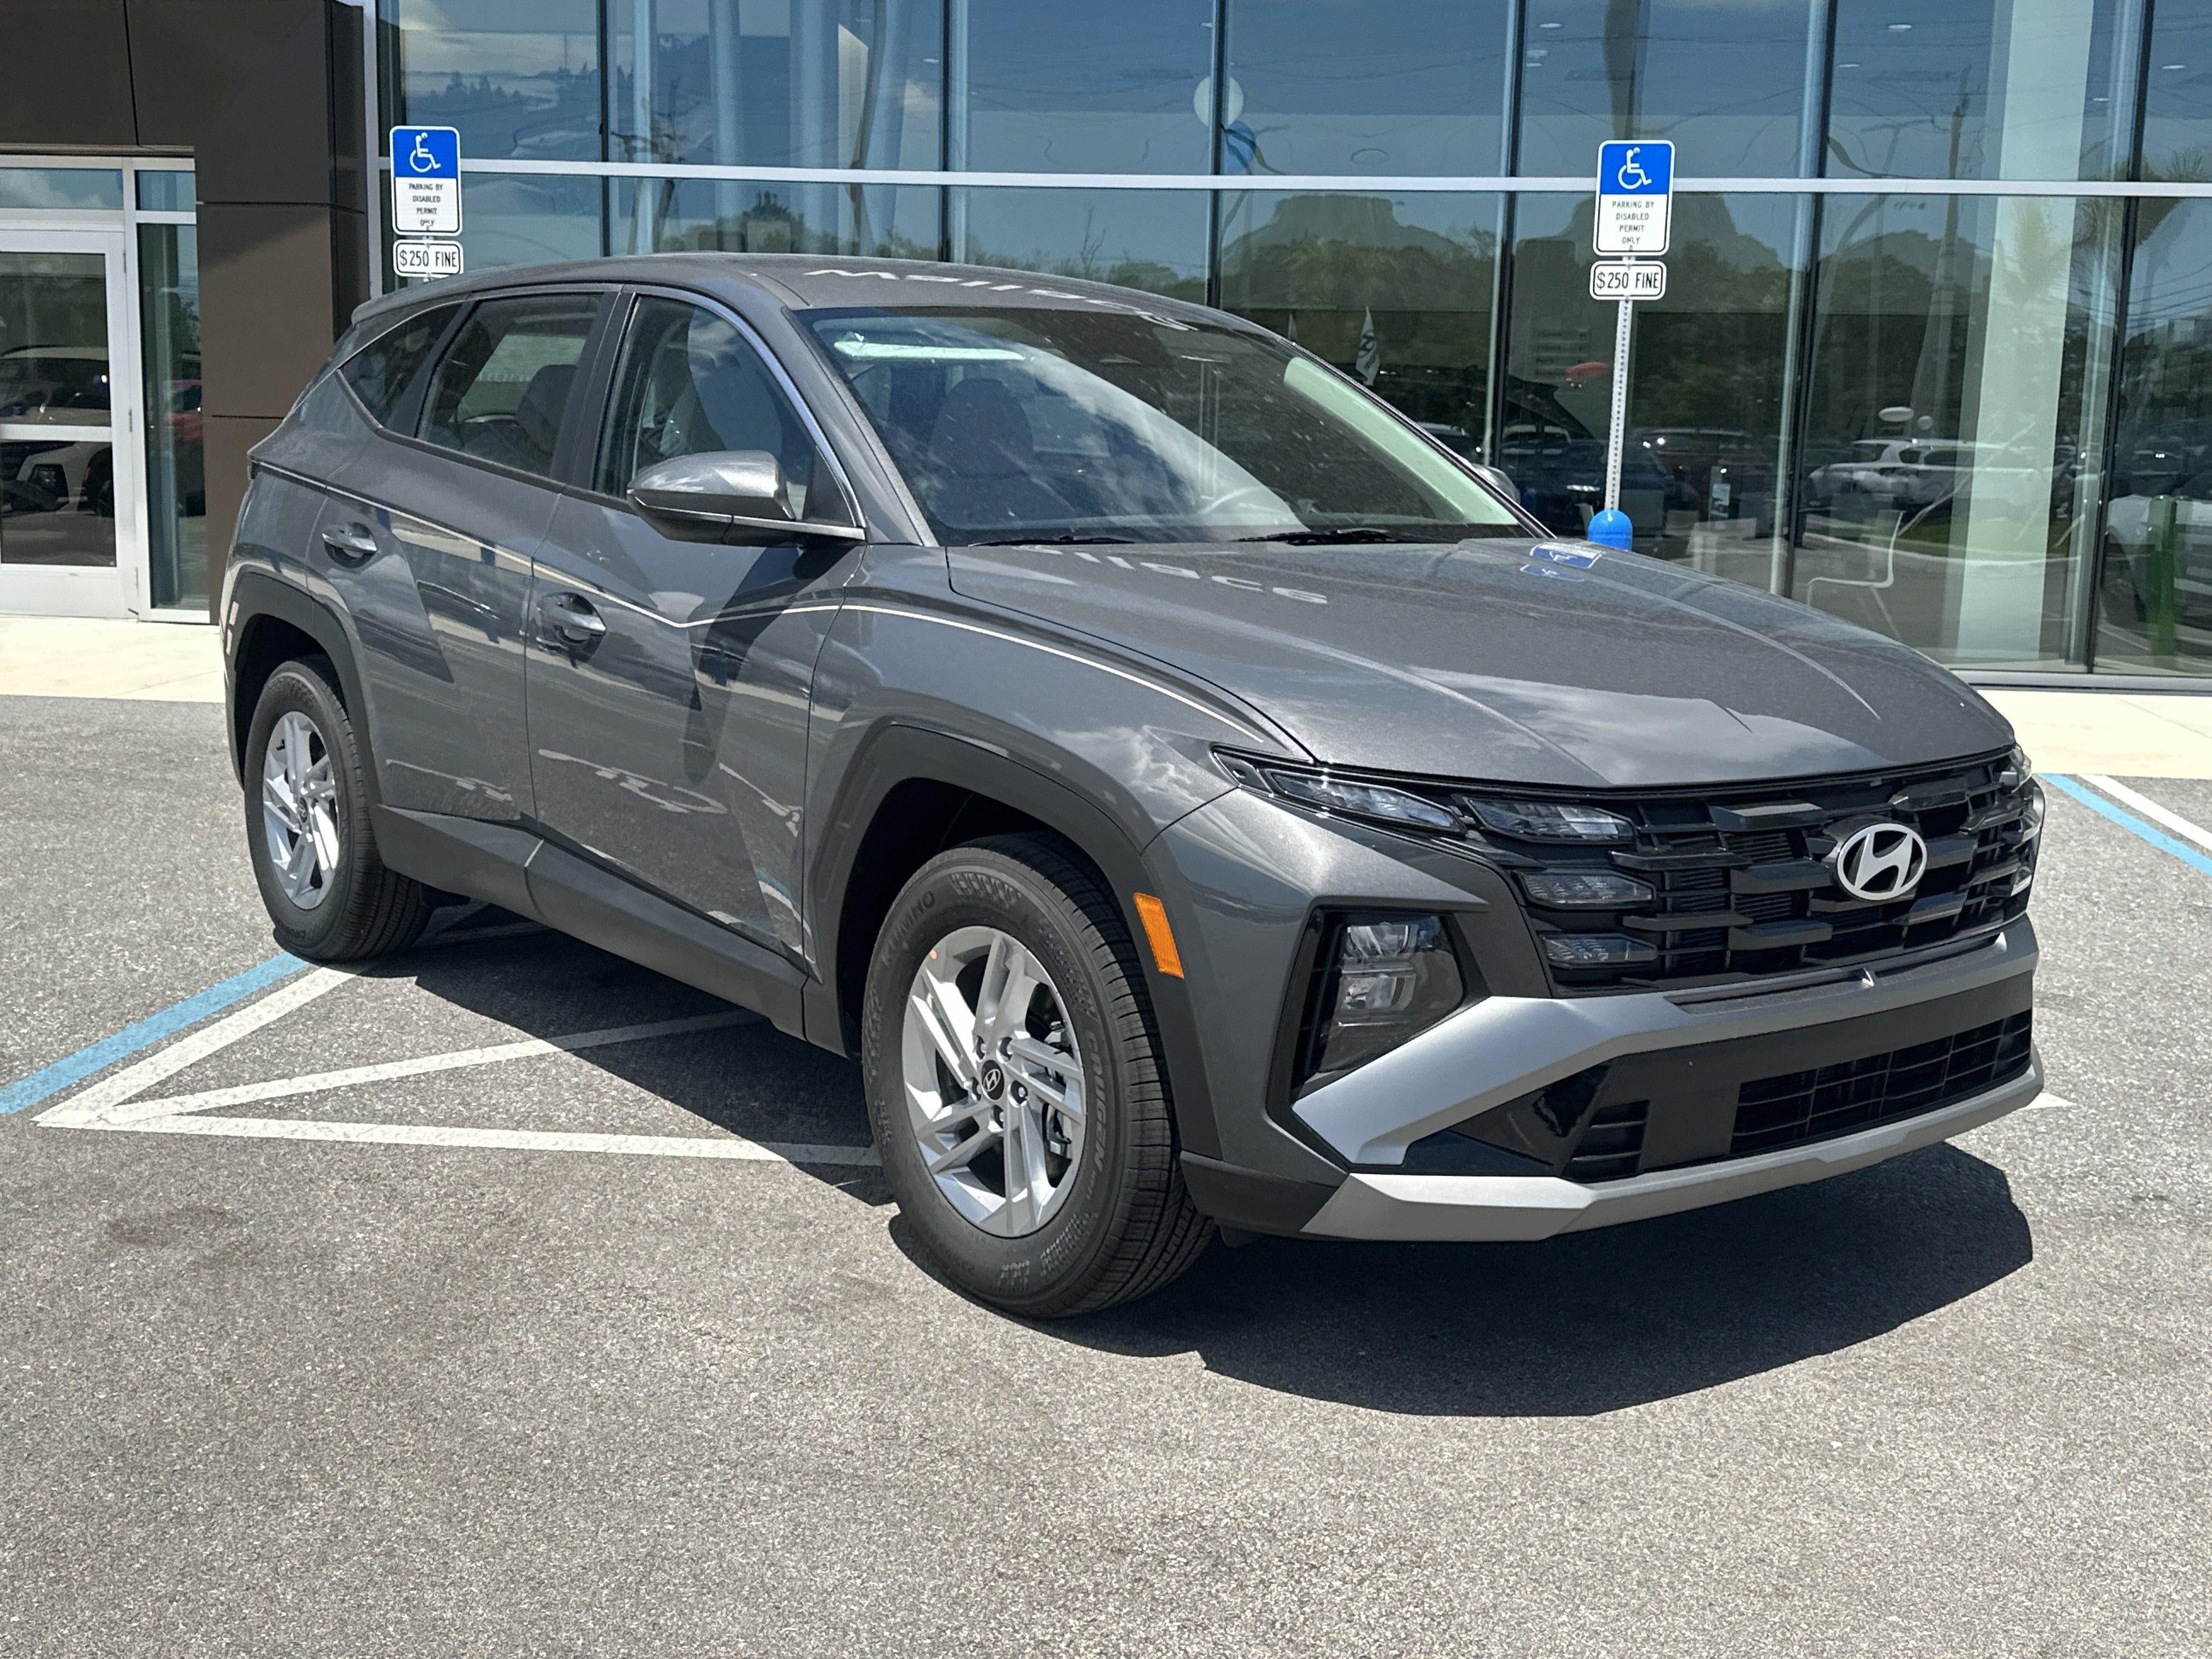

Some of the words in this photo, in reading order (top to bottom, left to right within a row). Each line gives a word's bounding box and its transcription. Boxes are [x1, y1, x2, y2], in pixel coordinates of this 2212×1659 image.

[1616, 212, 1650, 221] DISABLED
[1619, 224, 1645, 233] PERMIT
[1622, 236, 1641, 245] ONLY
[399, 249, 430, 267] $250
[435, 251, 458, 268] FINE
[1596, 270, 1629, 290] $250
[1635, 272, 1660, 289] FINE
